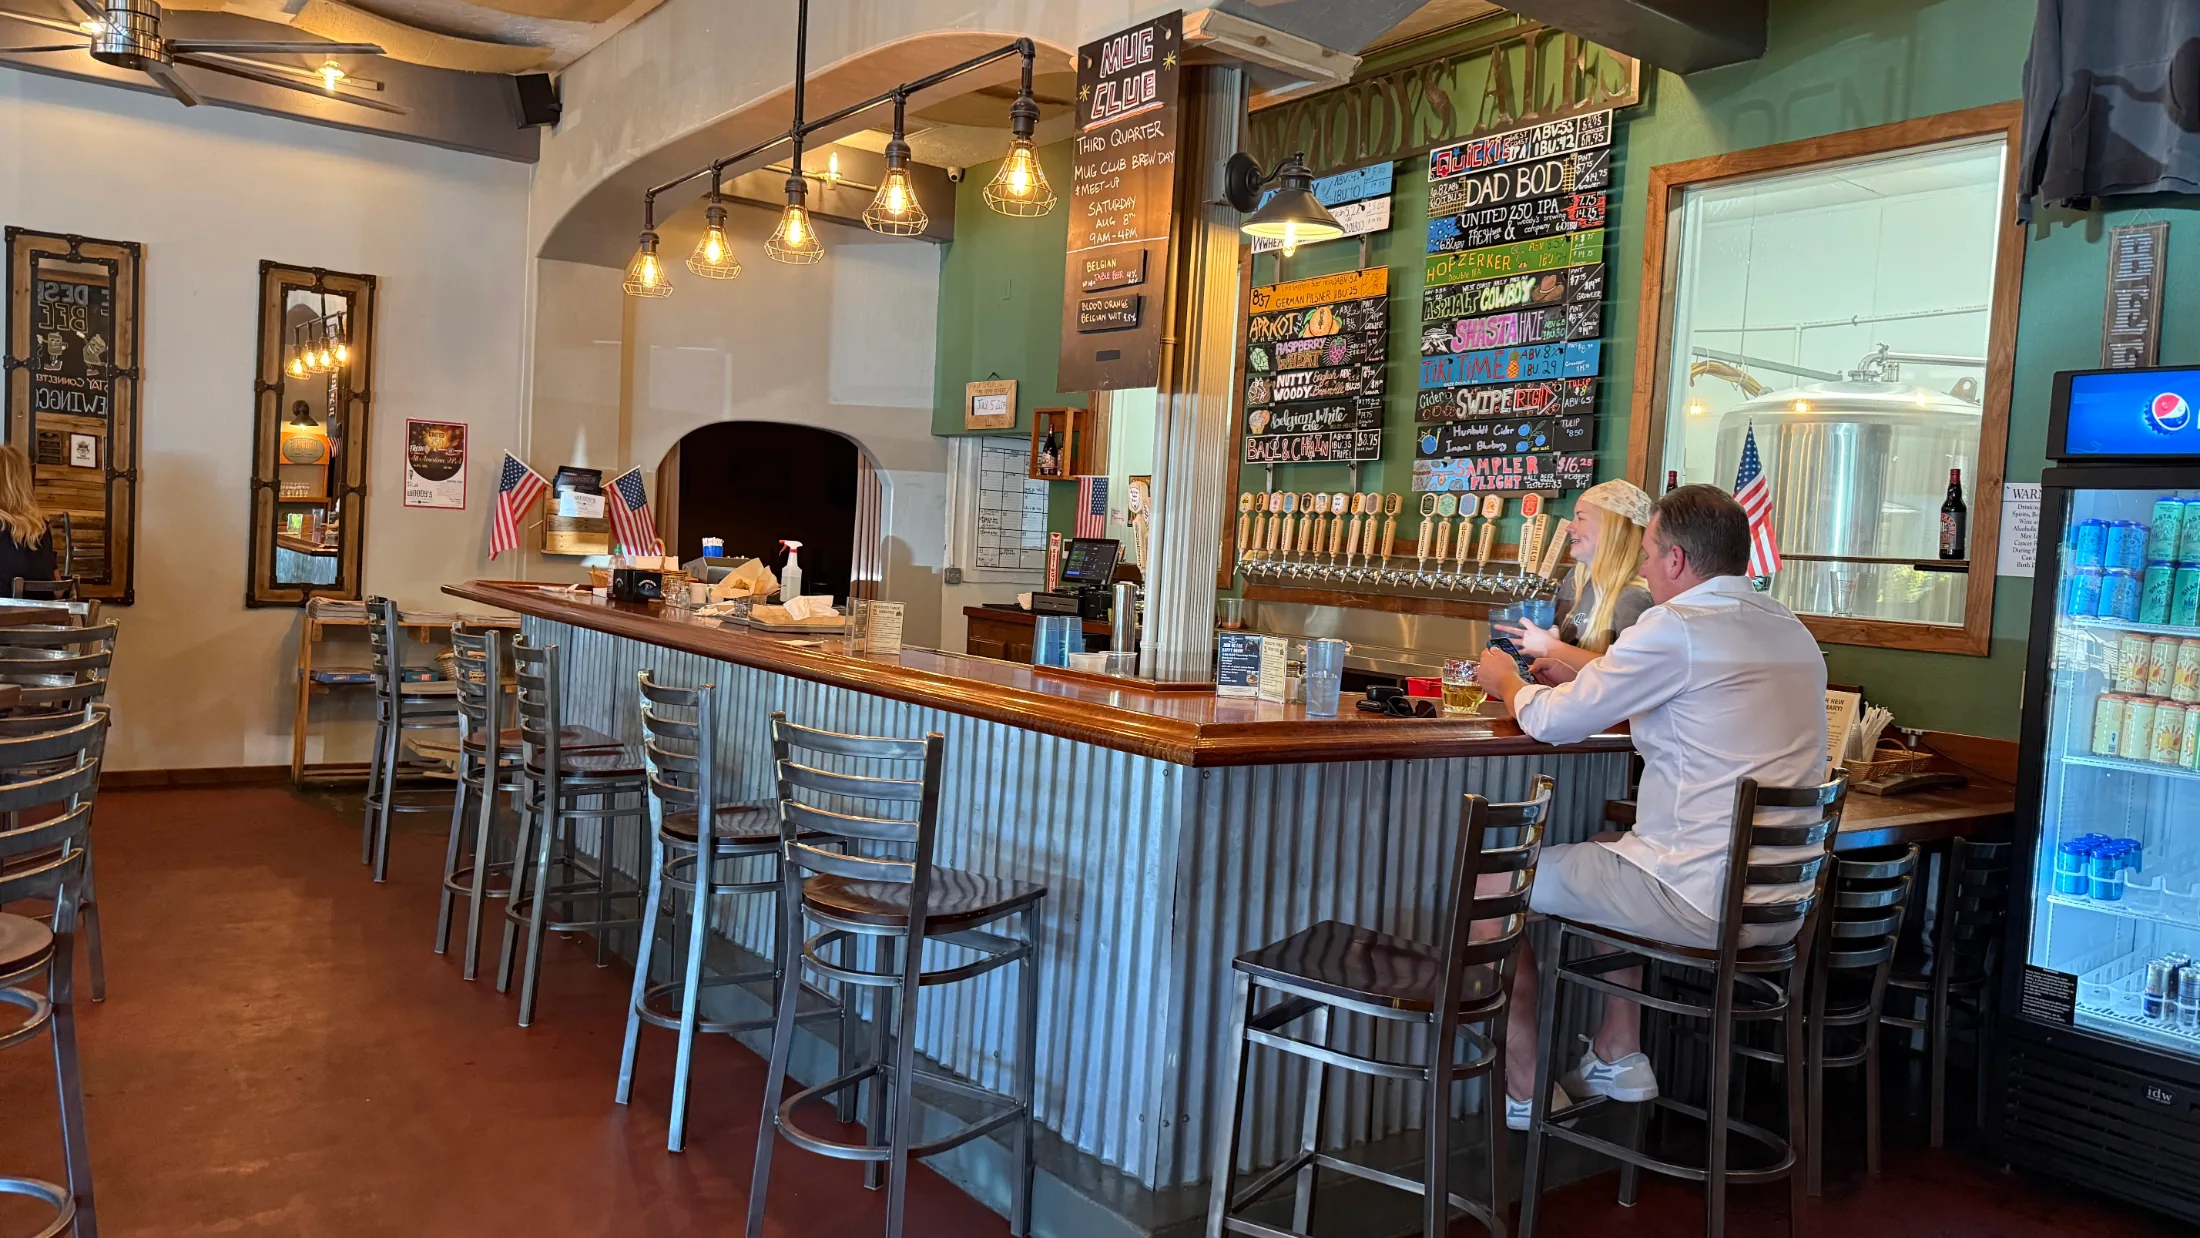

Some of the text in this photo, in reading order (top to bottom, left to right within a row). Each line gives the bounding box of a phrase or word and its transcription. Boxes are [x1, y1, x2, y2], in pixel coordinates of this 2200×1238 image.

[1100, 27, 1153, 78] MUG
[1091, 69, 1156, 119] CLUB
[1076, 120, 1164, 155] THIRD QUARTER
[1510, 131, 1528, 140] WEST
[1510, 138, 1528, 147] COAST
[1074, 150, 1175, 180] MUG CLUB BREW DAY
[1577, 153, 1593, 162] PINT
[1082, 177, 1120, 196] MEET-UP
[1464, 161, 1564, 207] DAD BOD
[1088, 196, 1136, 216] SATURDAY
[1461, 198, 1559, 228] UNITED 250 IPA
[1096, 216, 1116, 229] AUG
[1544, 213, 1567, 221] brewing
[1089, 228, 1137, 245] 9AM-4PM
[1469, 227, 1492, 247] FRESH
[1504, 220, 1516, 240] &
[1087, 259, 1116, 273] BELGIAN
[1094, 271, 1110, 281] TABLE
[1082, 299, 1128, 312] BLOOD ORANGE
[1253, 289, 1331, 309] 837 GERMAN PILSNER
[1424, 277, 1536, 320] ASPHALT COWBOY
[1081, 313, 1106, 324] BELGIAN
[1108, 312, 1122, 321] WIT
[1451, 311, 1545, 353] SHASTA HAZE
[1276, 337, 1328, 355] RASPBERRY
[1520, 348, 1541, 360] ABV
[1276, 350, 1324, 370] WHEAT
[1523, 360, 1557, 377] IBU 29
[1277, 371, 1314, 388] NUTTY
[1274, 384, 1313, 401] WOODY
[1420, 386, 1552, 419] Cider SWIPE RIGHT
[1561, 418, 1580, 428] TULIP
[1248, 434, 1329, 461] BALL & CHAIN
[1332, 449, 1352, 459] TRIPEL
[1456, 455, 1538, 477] SAMPLER
[1557, 456, 1594, 473] $16.25
[1470, 474, 1522, 490] FLIGHT
[1552, 480, 1562, 488] $3
[1576, 480, 1587, 488] $4
[1831, 698, 1845, 706] NEW
[2147, 1085, 2172, 1101] idw
